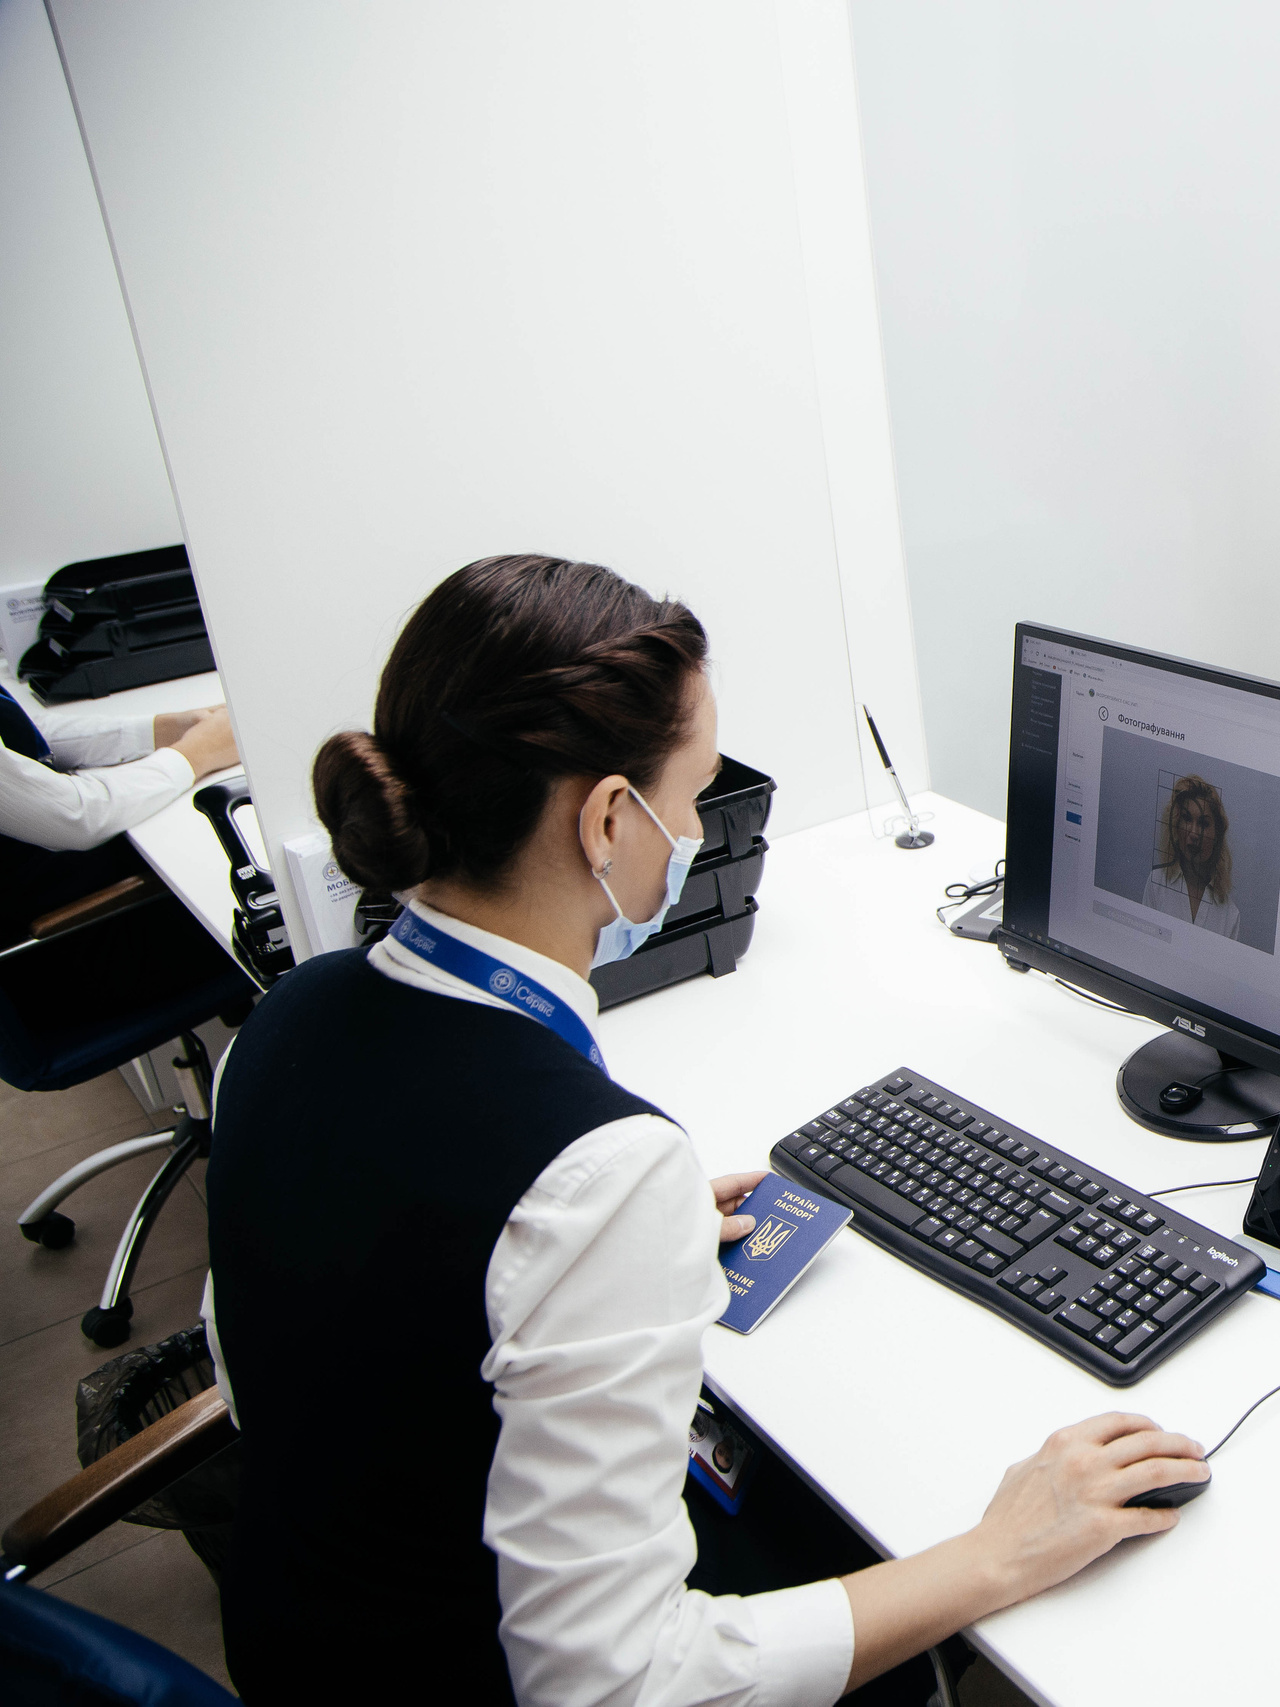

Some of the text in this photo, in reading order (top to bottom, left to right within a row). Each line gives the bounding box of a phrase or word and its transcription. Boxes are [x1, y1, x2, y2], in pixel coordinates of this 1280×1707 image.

[1118, 714, 1185, 741] Фотографування
[326, 878, 350, 893] МОБ
[516, 985, 553, 1018] Сервіс
[1172, 1016, 1206, 1037] ASUS
[773, 1199, 814, 1221] ПАСПОРТ
[781, 1190, 821, 1213] УКРАЇНА
[1207, 1247, 1239, 1268] logitech
[721, 1266, 755, 1288] KRAINE
[727, 1281, 748, 1297] PORT
